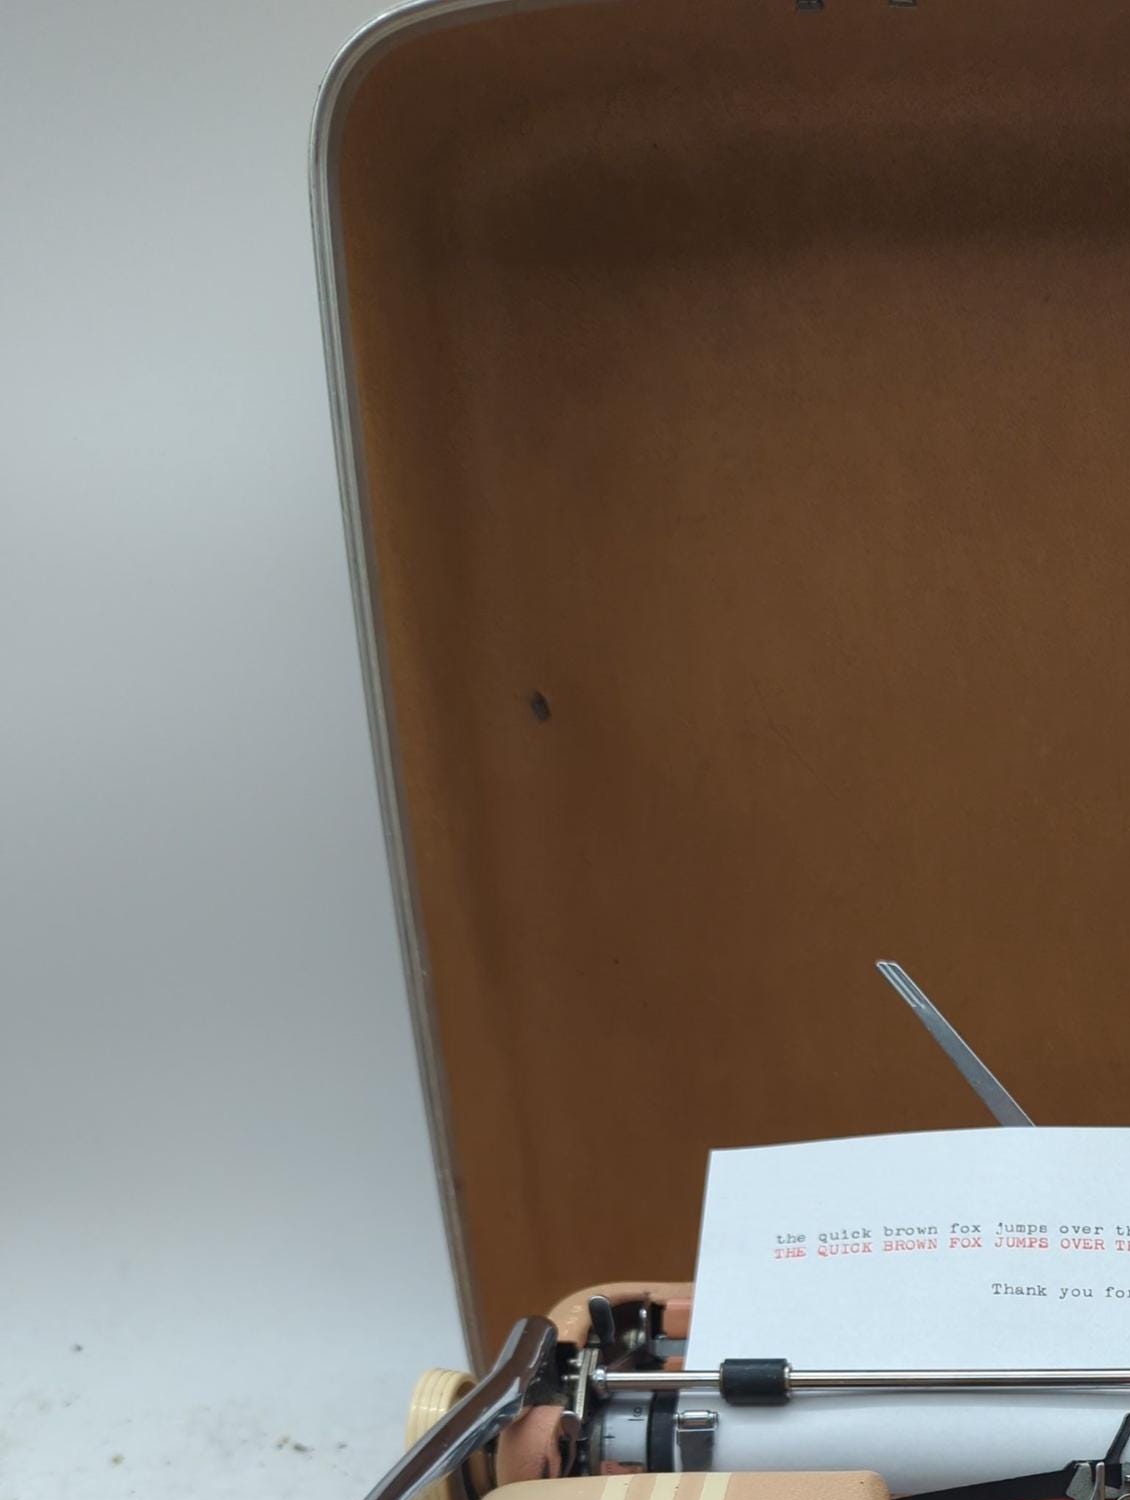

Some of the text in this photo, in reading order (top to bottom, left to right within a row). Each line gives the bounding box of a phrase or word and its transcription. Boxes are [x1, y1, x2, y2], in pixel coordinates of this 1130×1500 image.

[776, 1233, 806, 1245] the
[818, 1228, 872, 1244] quick
[883, 1226, 938, 1238] brown
[949, 1223, 982, 1234] fox
[995, 1222, 1048, 1236] jumps
[1059, 1225, 1104, 1235] over
[775, 1246, 807, 1259] THE
[817, 1241, 873, 1257] QUICK
[883, 1238, 938, 1252] BROWN
[949, 1237, 983, 1249] FOX
[994, 1236, 1049, 1249] JUMPS
[1060, 1237, 1105, 1250] OVER
[991, 1283, 1048, 1297] Thank
[1058, 1287, 1094, 1300] you
